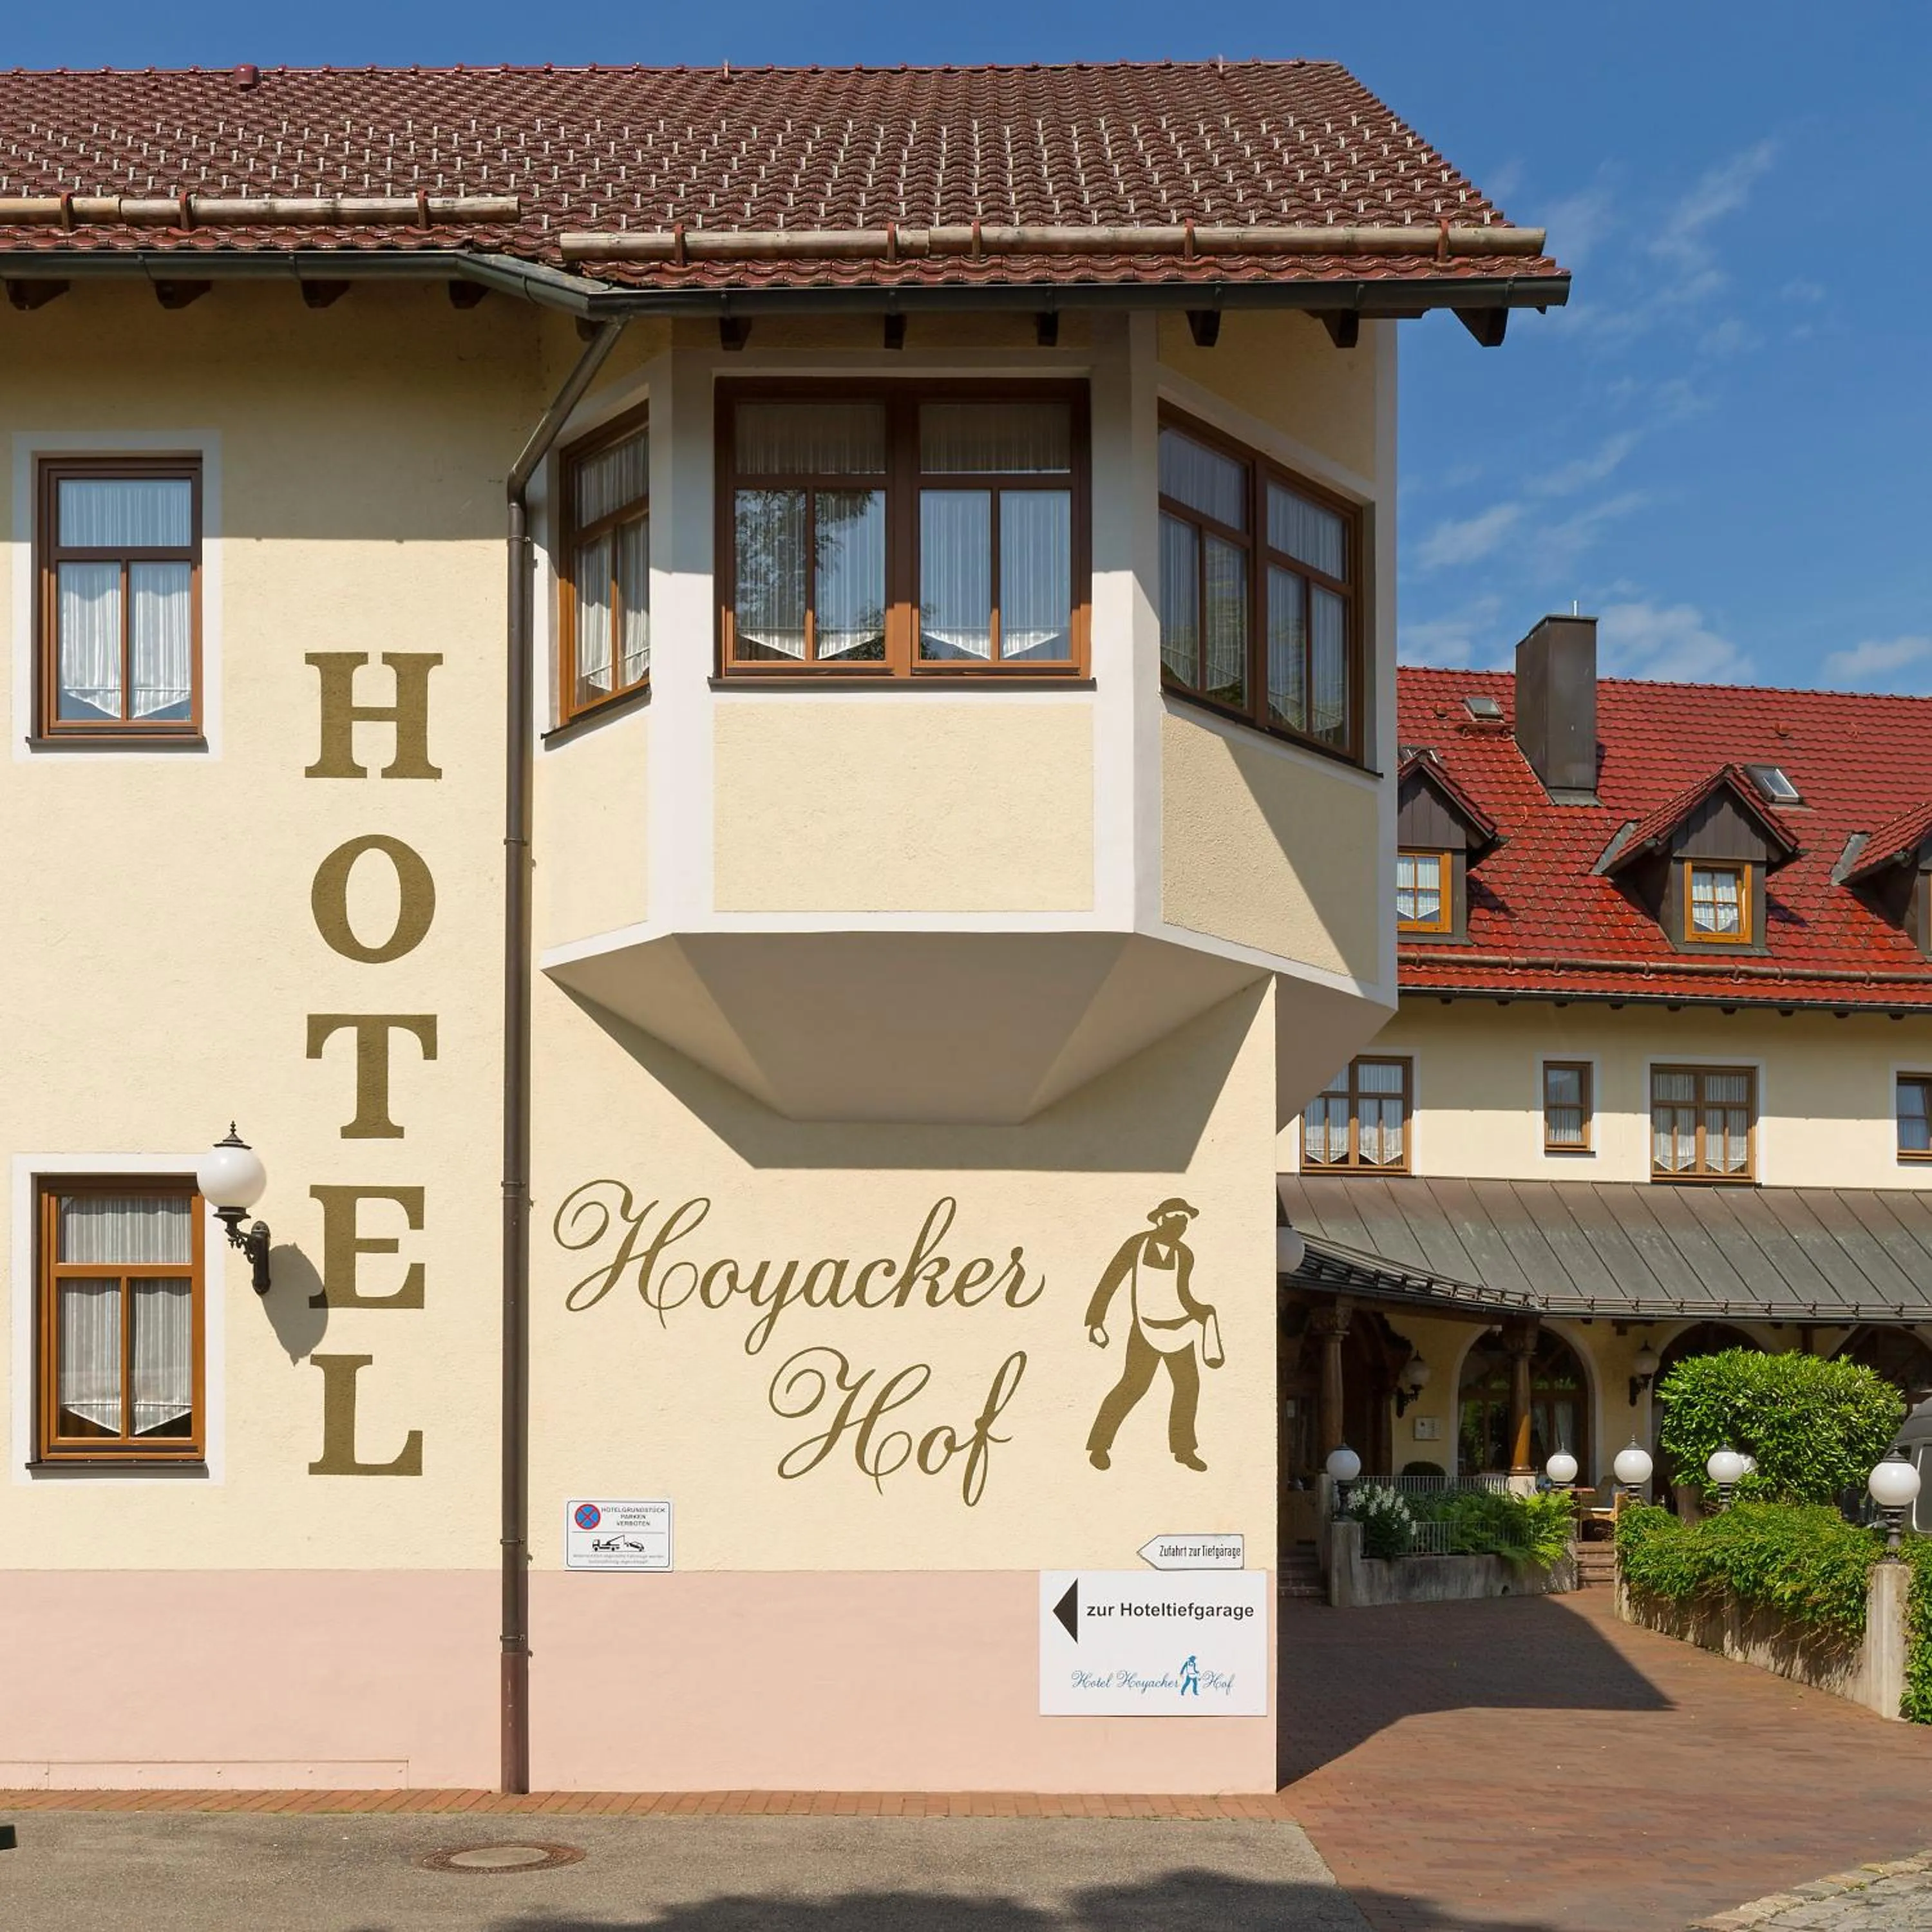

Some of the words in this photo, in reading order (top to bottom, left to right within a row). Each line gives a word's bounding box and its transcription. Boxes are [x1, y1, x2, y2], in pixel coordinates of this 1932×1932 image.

[305, 652, 443, 1476] HOTEL
[553, 1179, 1045, 1356] Hoyacker
[768, 1346, 1028, 1507] Hof
[1159, 1545, 1186, 1557] Zufahrt
[1188, 1547, 1201, 1557] zur
[1202, 1544, 1241, 1558] Tiefgarage
[1086, 1605, 1115, 1616] zur
[1120, 1602, 1254, 1620] Hoteltiefgarage
[1071, 1669, 1113, 1690] Hotel
[1116, 1670, 1179, 1695] Hoyacker
[1200, 1670, 1236, 1696] Hof
